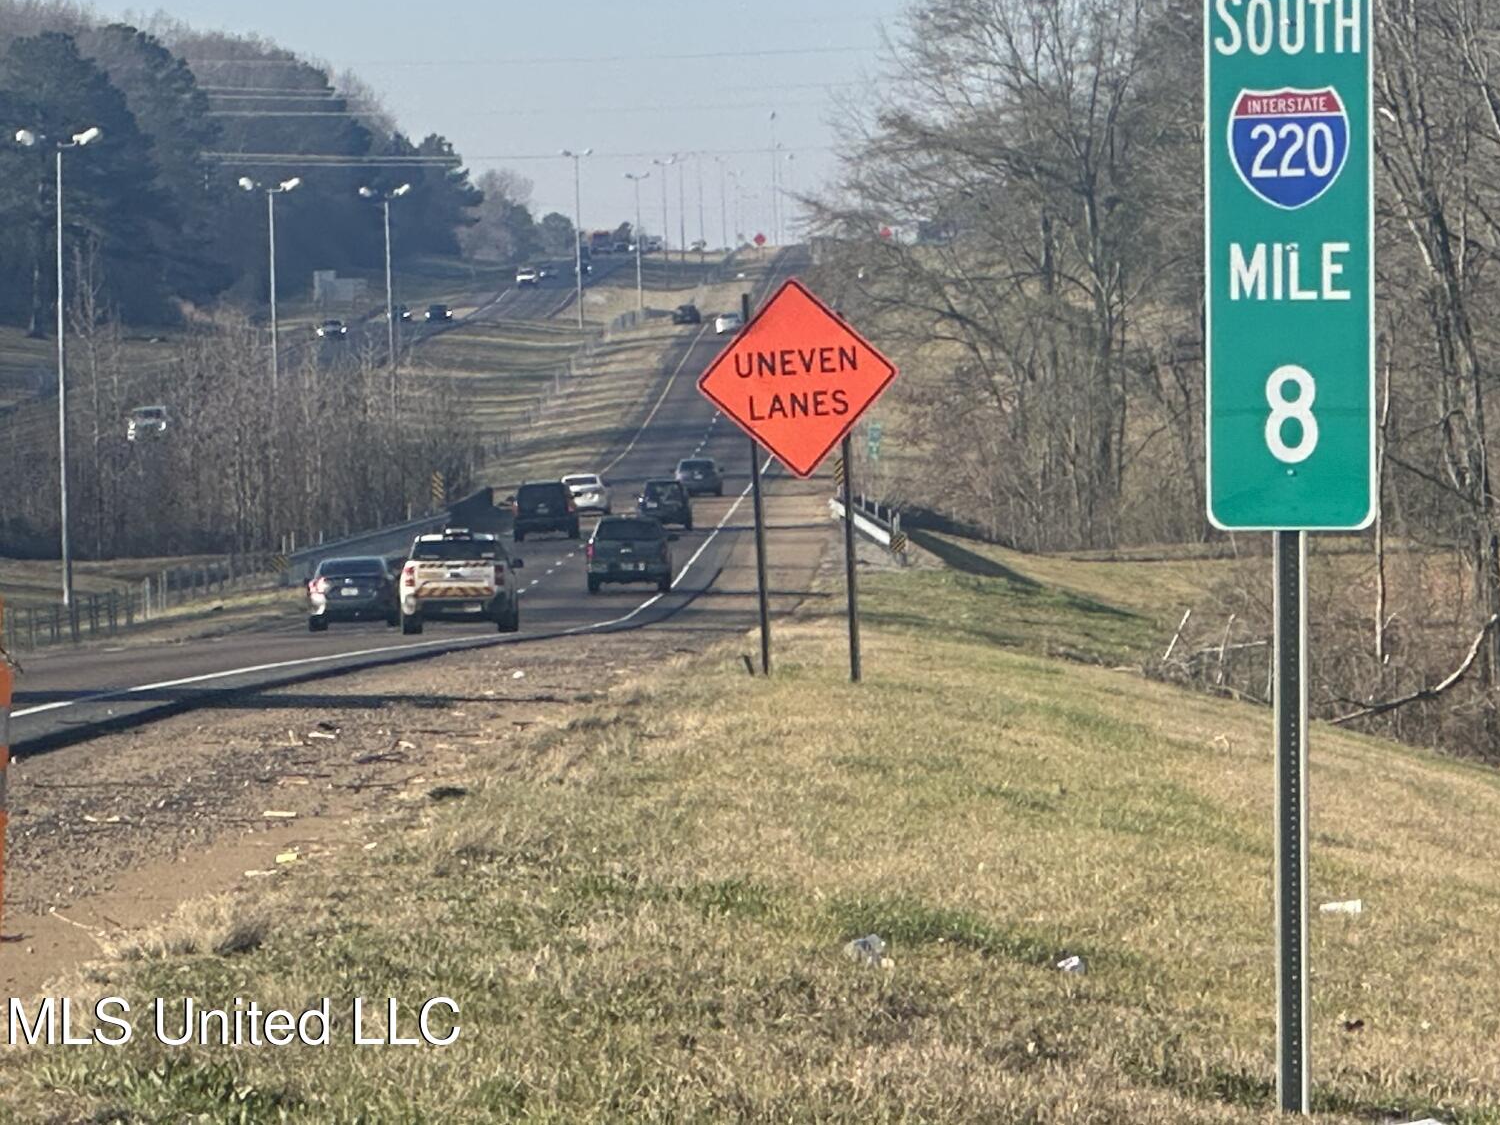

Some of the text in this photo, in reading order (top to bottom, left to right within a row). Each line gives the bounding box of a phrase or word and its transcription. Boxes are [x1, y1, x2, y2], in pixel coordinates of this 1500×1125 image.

[1247, 96, 1328, 114] INTERSTATE
[1250, 122, 1335, 178] 220
[1229, 242, 1351, 301] MILE
[734, 346, 858, 379] UNEVEN
[748, 389, 849, 421] LANES
[1264, 364, 1319, 464] 8
